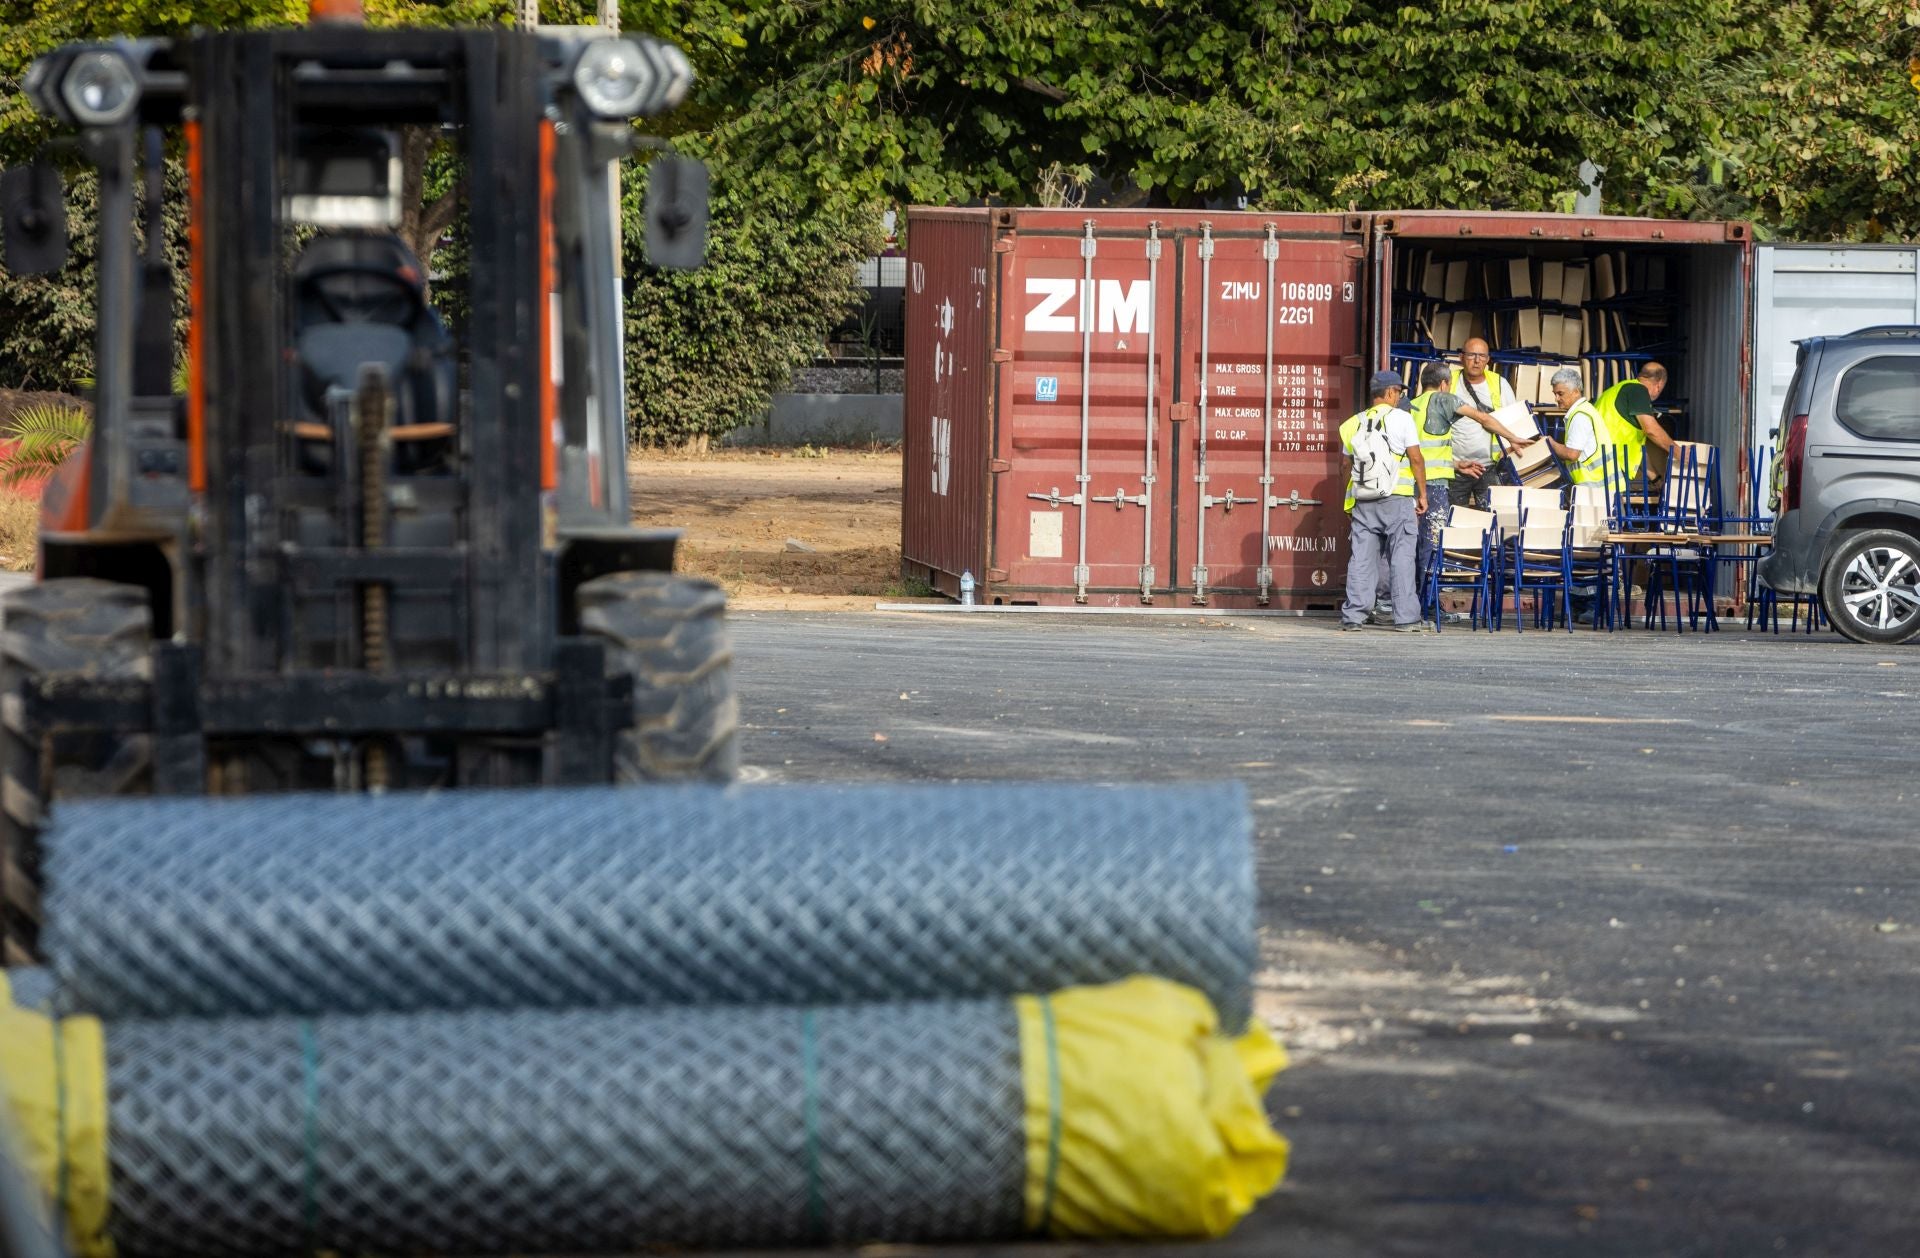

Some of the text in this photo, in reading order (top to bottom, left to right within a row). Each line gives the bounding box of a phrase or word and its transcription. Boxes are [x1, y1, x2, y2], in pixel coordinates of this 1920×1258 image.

[1221, 281, 1353, 301] ZIMU 106809 3
[1025, 278, 1150, 333] ZIM
[1279, 306, 1314, 325] 22G1
[1215, 363, 1261, 374] MAX. GROSS
[1278, 365, 1322, 377] 30.480 kg
[1278, 376, 1325, 386] 67.200 lbs
[1216, 385, 1237, 396] TARE
[1283, 387, 1323, 399] 2.260 kg
[1312, 399, 1325, 408] lbs
[1215, 407, 1261, 418] MAX. CARGO
[1312, 410, 1322, 421] kg
[1312, 421, 1325, 430] lbs
[1215, 430, 1249, 441] CU. CAP.
[1282, 431, 1301, 441] 33.1
[1278, 442, 1324, 453] 1.170 cu.ft
